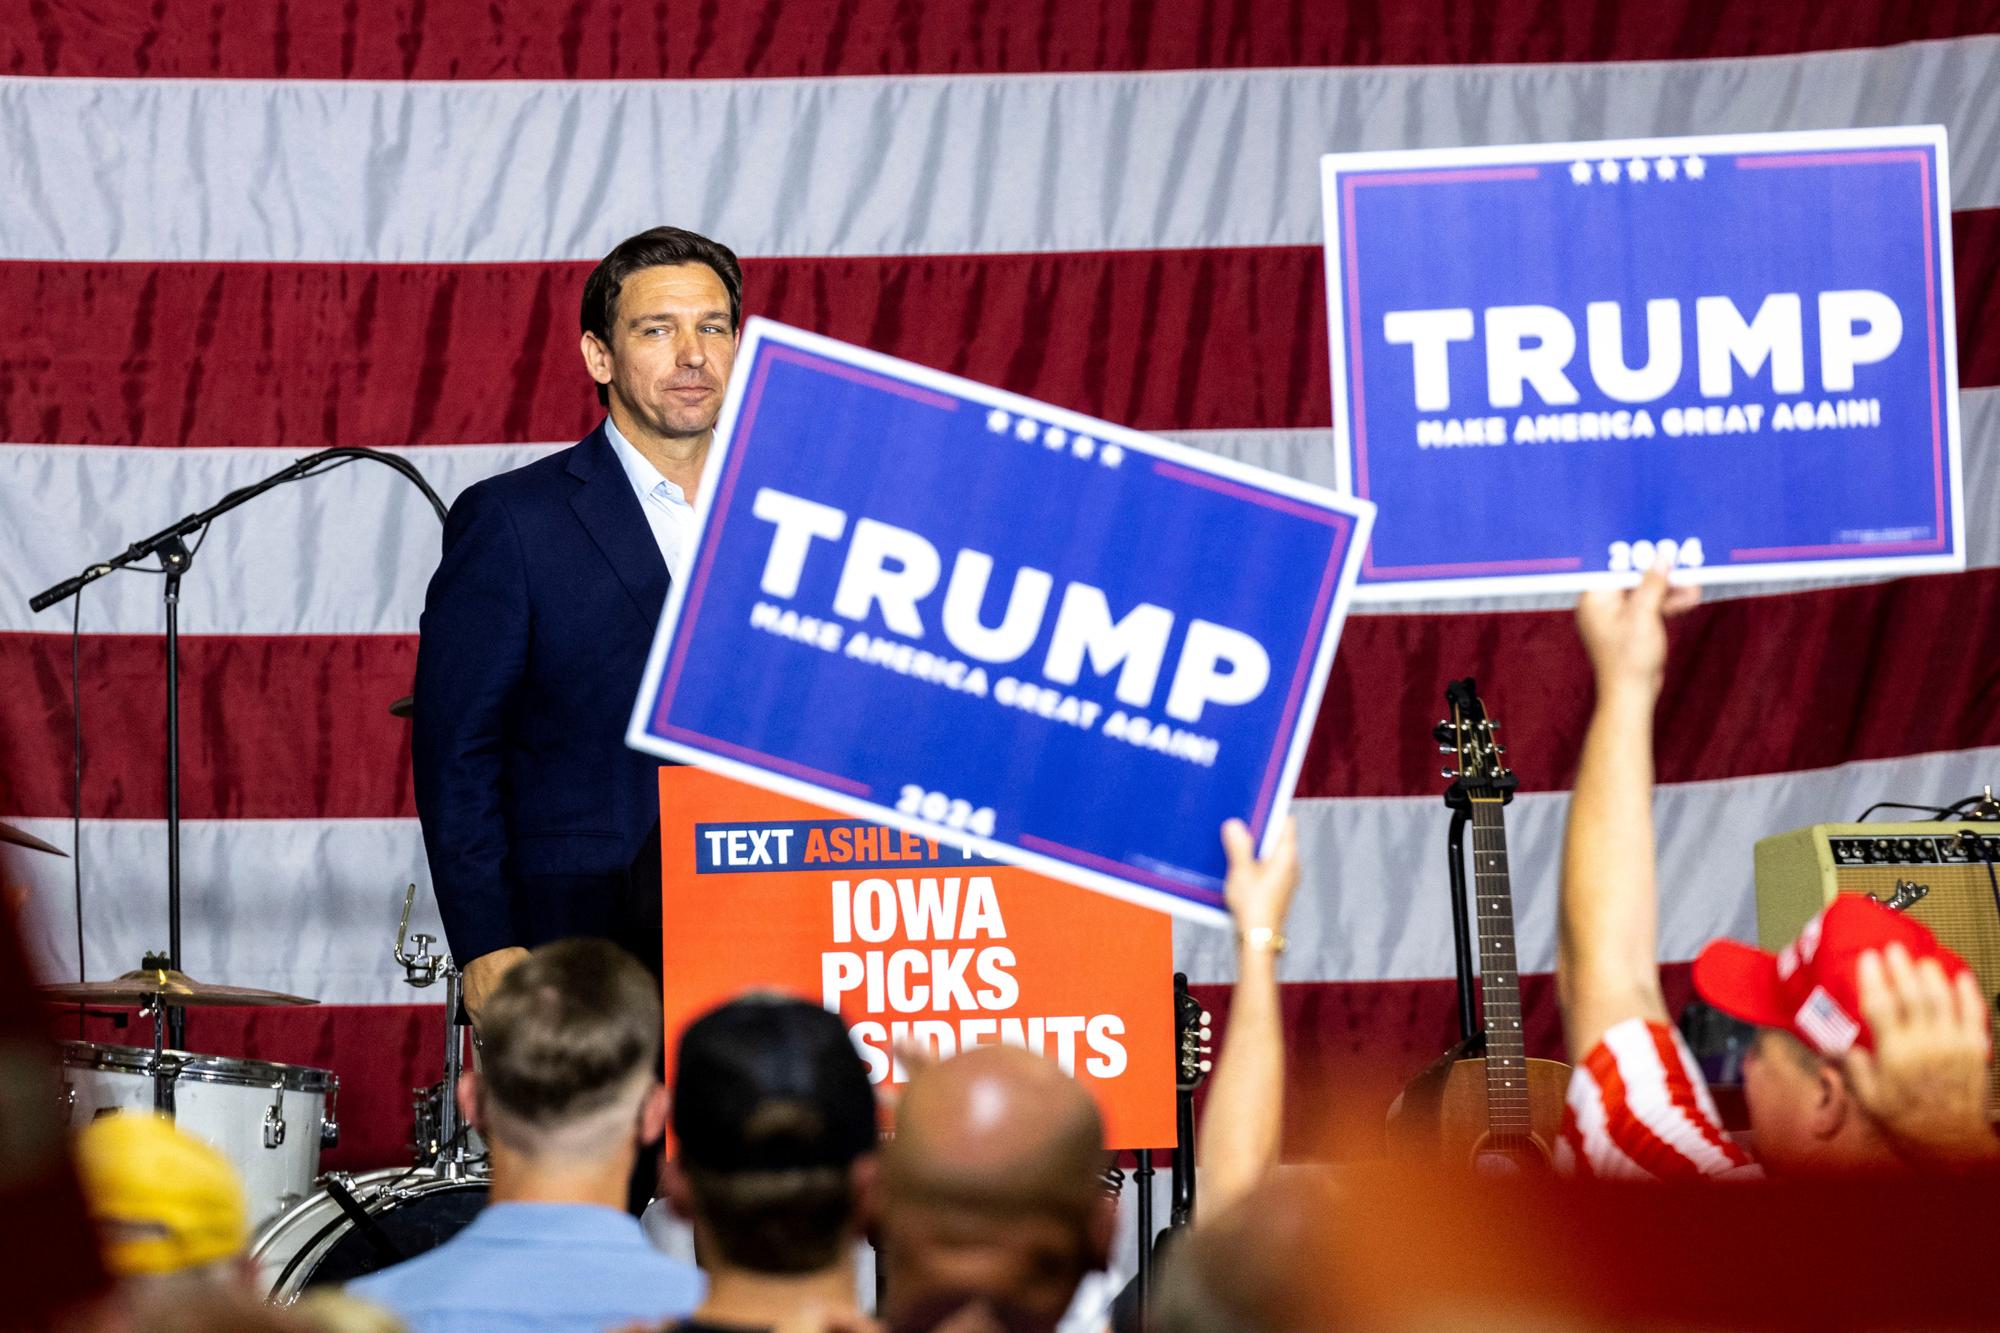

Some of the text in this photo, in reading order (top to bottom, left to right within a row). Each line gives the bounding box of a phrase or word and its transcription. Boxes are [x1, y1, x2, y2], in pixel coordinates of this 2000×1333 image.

[1383, 289, 1904, 412] TRUMP
[1416, 398, 1881, 450] MAKE AMERICA GREAT AGAIN!
[753, 487, 1271, 723] TRUMP
[750, 602, 1220, 767] MAKE AMERICA GREAT AGAIN!
[896, 783, 997, 838] 2024
[704, 828, 794, 866] TEXT
[803, 828, 941, 863] ASHLEY
[831, 876, 1008, 944] IOWA
[821, 946, 1020, 1014] PICKS
[849, 1013, 1128, 1085] SIDENTS
